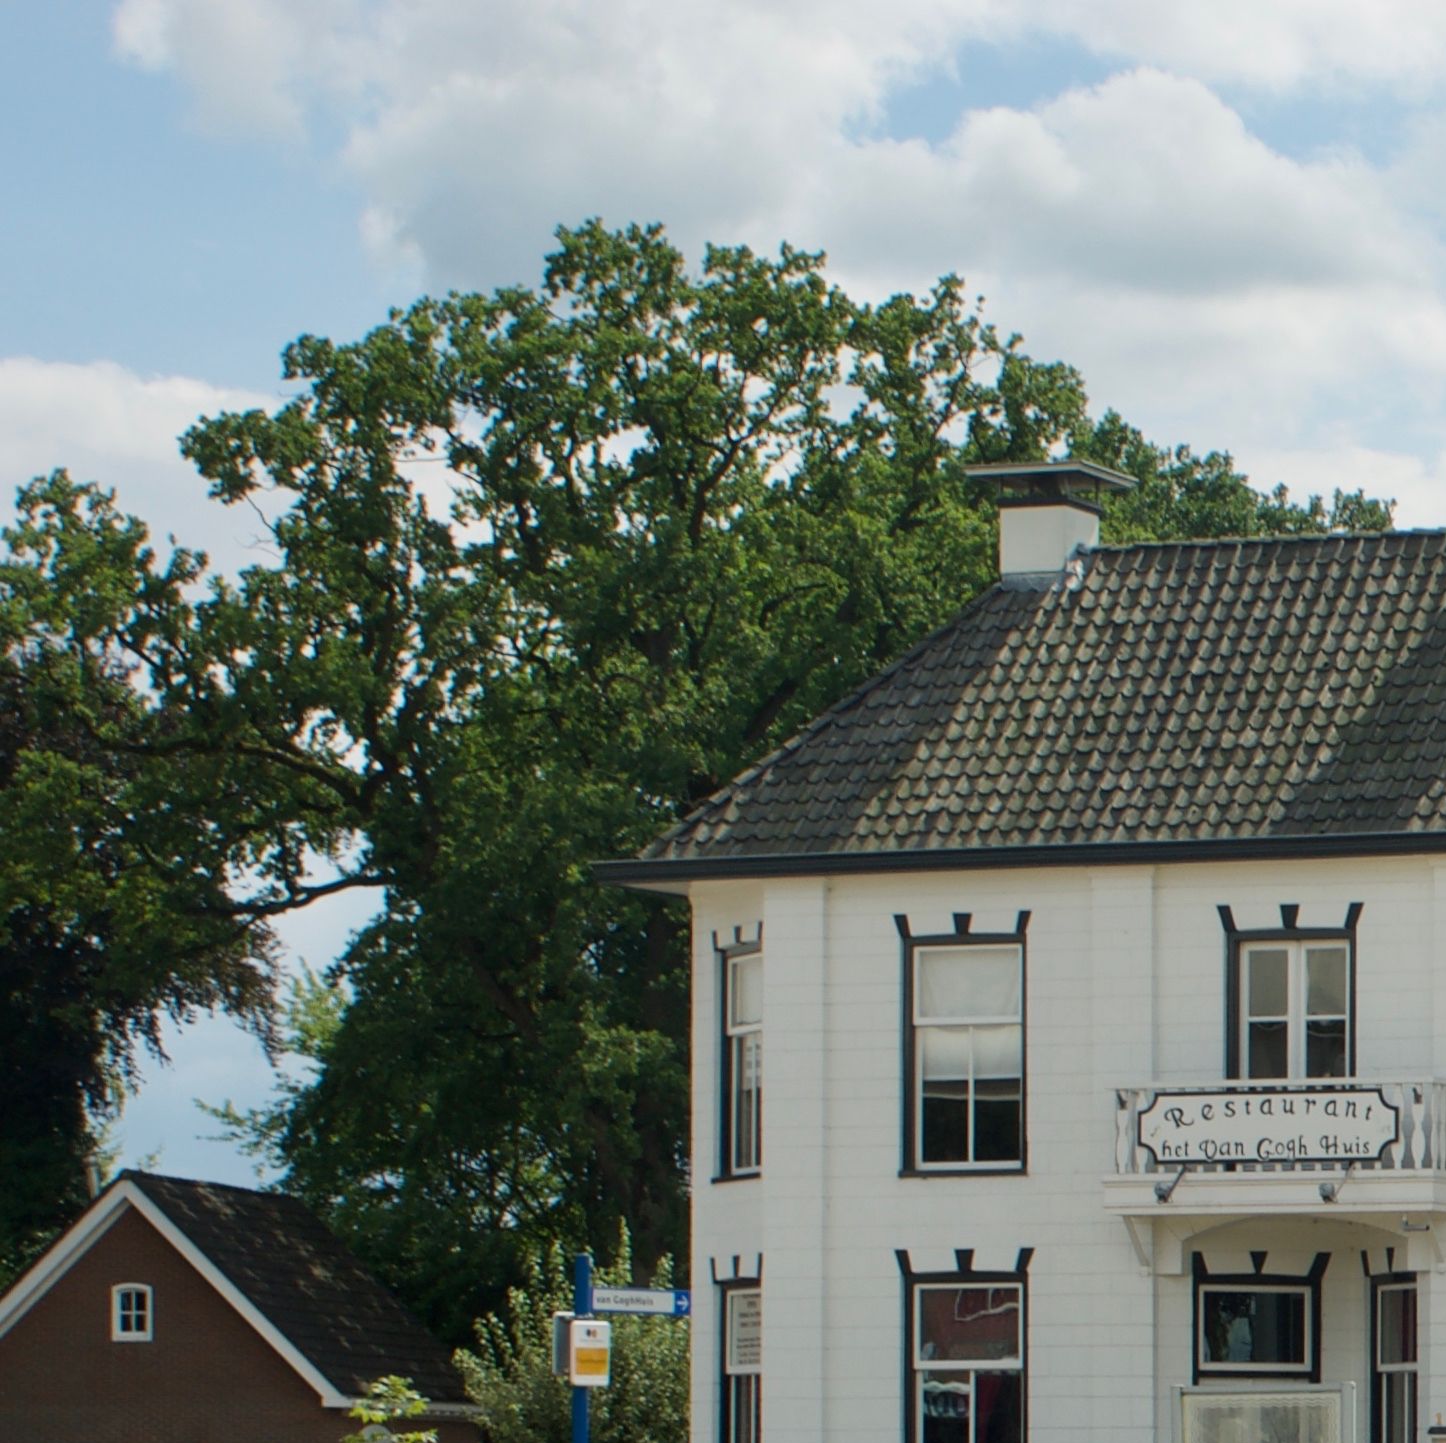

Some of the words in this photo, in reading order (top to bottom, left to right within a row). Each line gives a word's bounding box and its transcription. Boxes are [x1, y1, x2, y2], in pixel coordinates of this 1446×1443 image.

[1163, 1097, 1374, 1128] Restaurant
[1161, 1138, 1190, 1158] het
[1198, 1138, 1246, 1160] Van
[1256, 1134, 1309, 1160] Gogh
[1319, 1134, 1371, 1155] Huis
